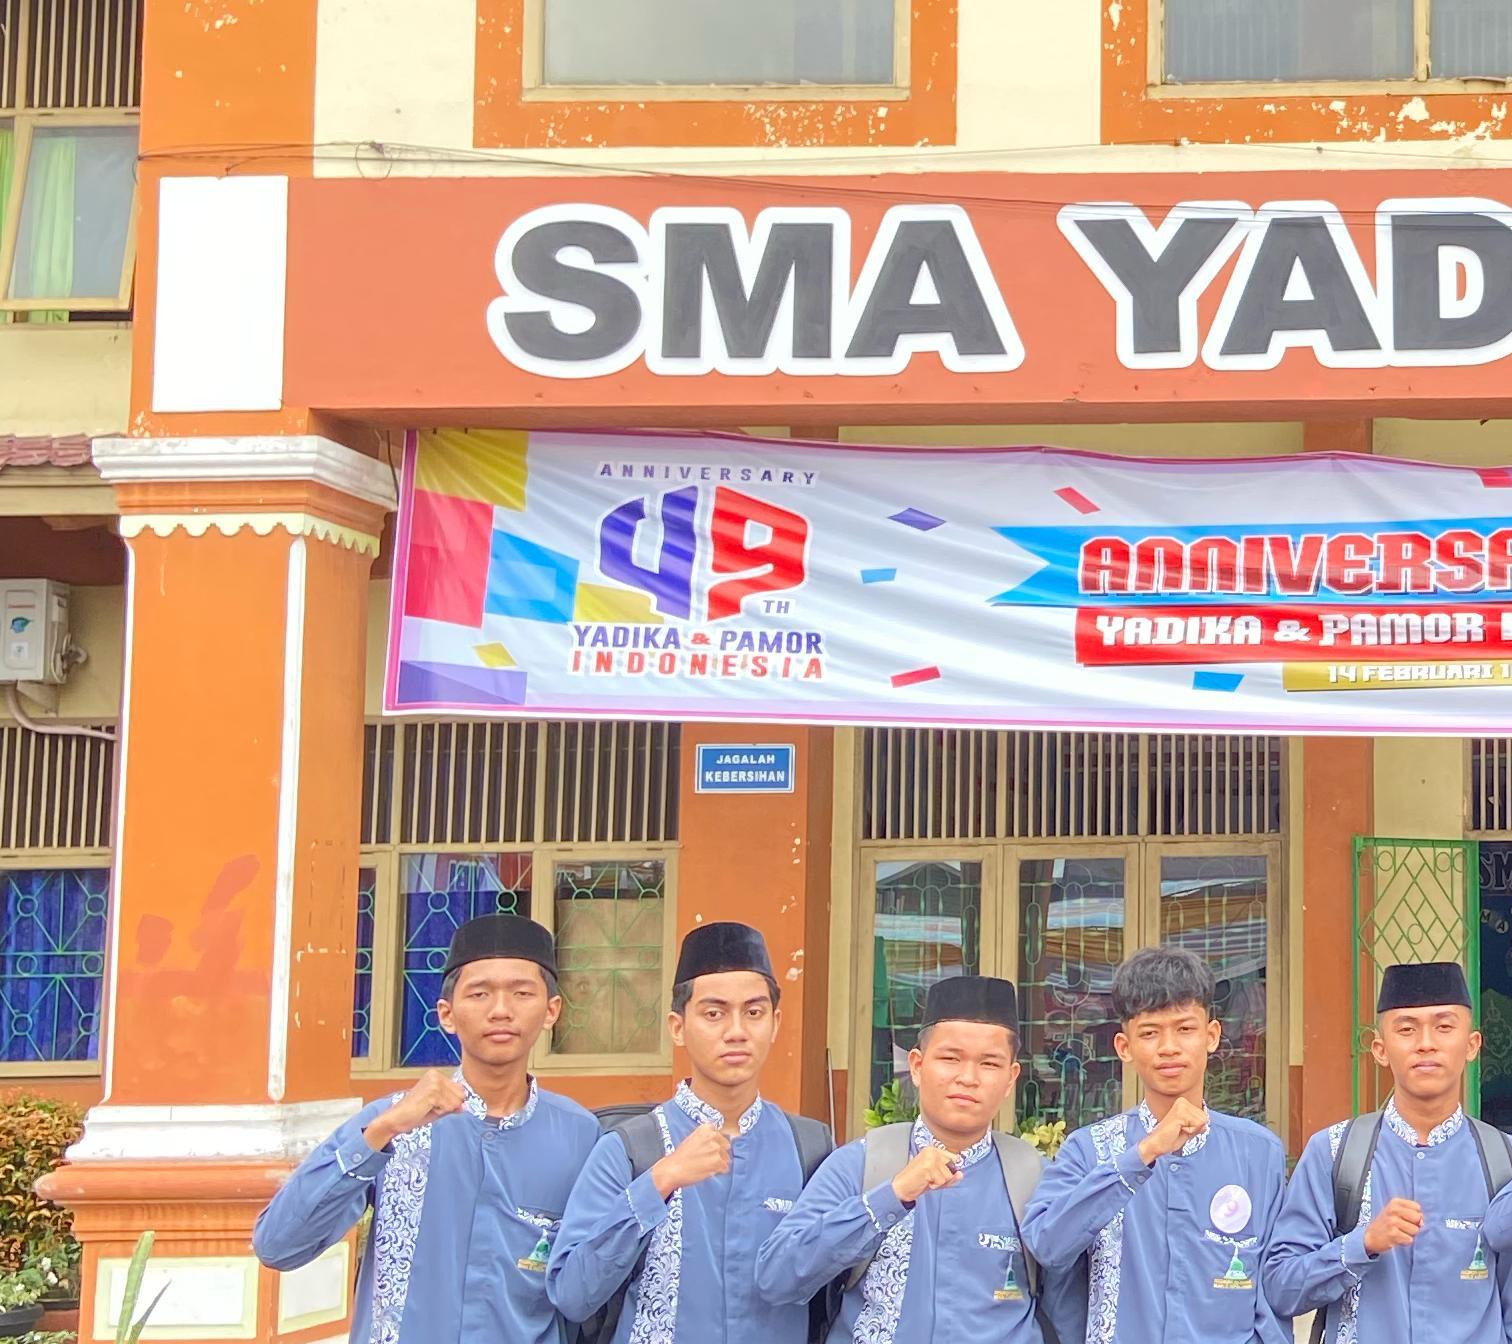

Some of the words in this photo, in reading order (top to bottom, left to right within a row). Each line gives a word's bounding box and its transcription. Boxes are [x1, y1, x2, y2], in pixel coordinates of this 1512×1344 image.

[502, 218, 1010, 362] SMA
[600, 463, 815, 485] ANNIVERSARY
[599, 485, 810, 622] 49
[762, 599, 791, 615] TH
[573, 625, 681, 649] YADIKA
[690, 632, 711, 645] &
[720, 629, 823, 654] PAMOR
[1095, 615, 1262, 646] YADIKA
[1273, 619, 1311, 643] &
[1317, 612, 1485, 646] PAMOR
[572, 650, 823, 679] INDONESIA
[1327, 664, 1358, 683] 14
[1362, 664, 1494, 682] FEBRUARI
[715, 754, 776, 765] JAGALAH
[704, 770, 785, 783] KEBERSIHAN
